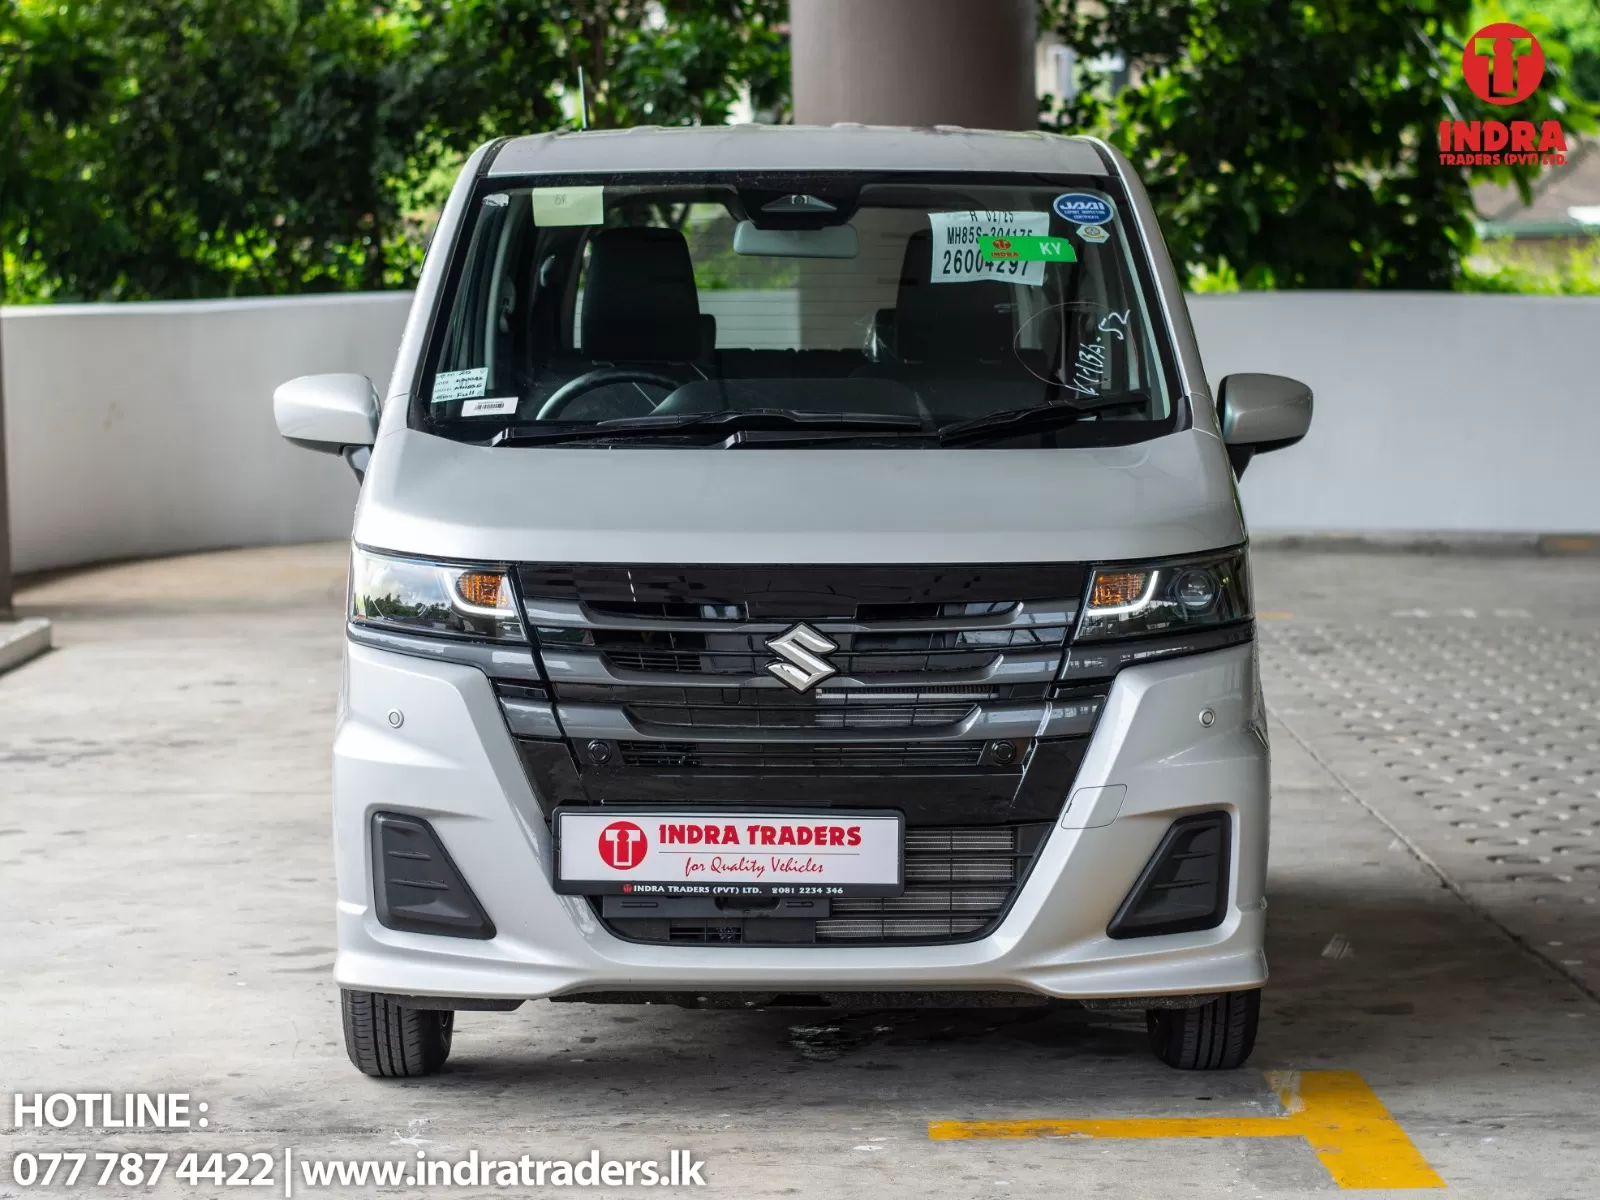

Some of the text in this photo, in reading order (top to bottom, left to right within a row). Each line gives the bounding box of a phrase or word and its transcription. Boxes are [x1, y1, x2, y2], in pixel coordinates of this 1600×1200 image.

[1059, 201, 1105, 210] JAAI
[1039, 242, 1062, 256] KY
[658, 824, 862, 846] INDRA TRADERS
[685, 856, 824, 878] for Quality Vehicles
[633, 884, 665, 893] INDRA
[667, 885, 710, 894] TRADERS
[712, 885, 740, 895] (PVT)
[742, 886, 763, 894] LTD.
[799, 886, 823, 895] 2234
[826, 886, 844, 895] 346
